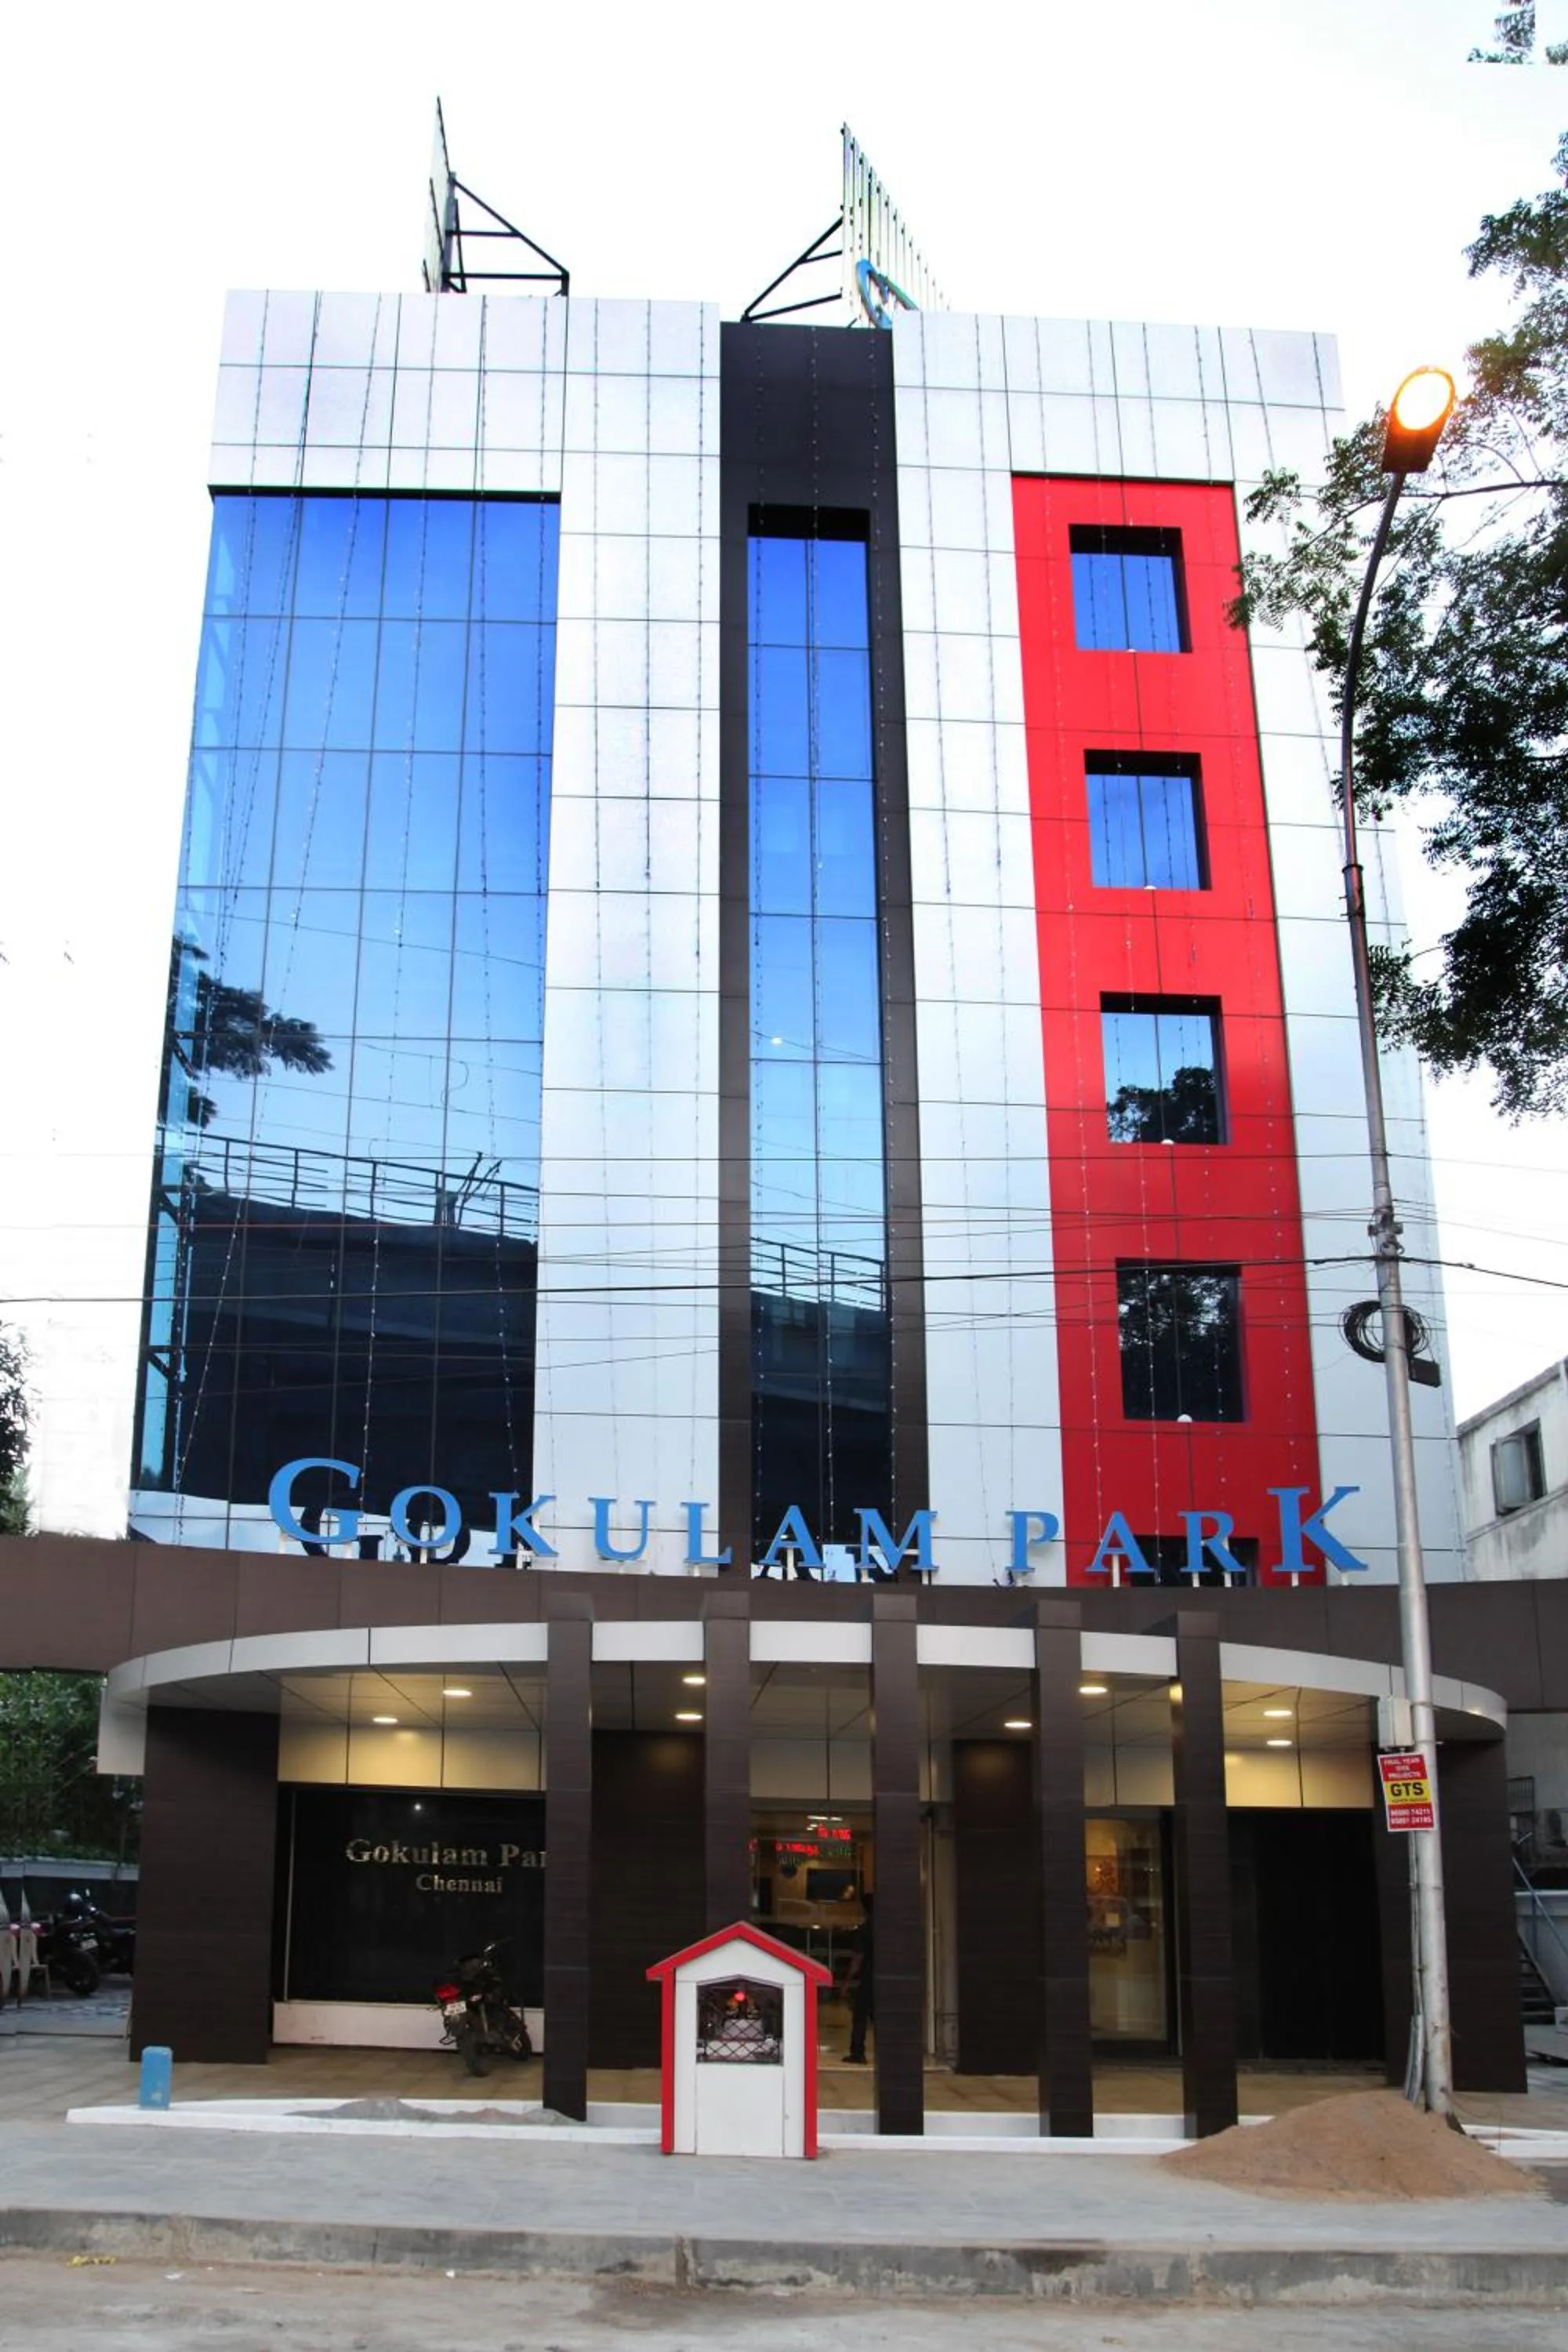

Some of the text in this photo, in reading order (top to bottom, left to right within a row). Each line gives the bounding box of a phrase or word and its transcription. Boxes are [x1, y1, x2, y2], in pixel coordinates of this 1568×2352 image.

[268, 1457, 1369, 1573] GOKULAM PARK
[1390, 1782, 1424, 1797] GTS
[345, 1838, 546, 1868] Gokulam Par
[416, 1874, 503, 1894] Chennai
